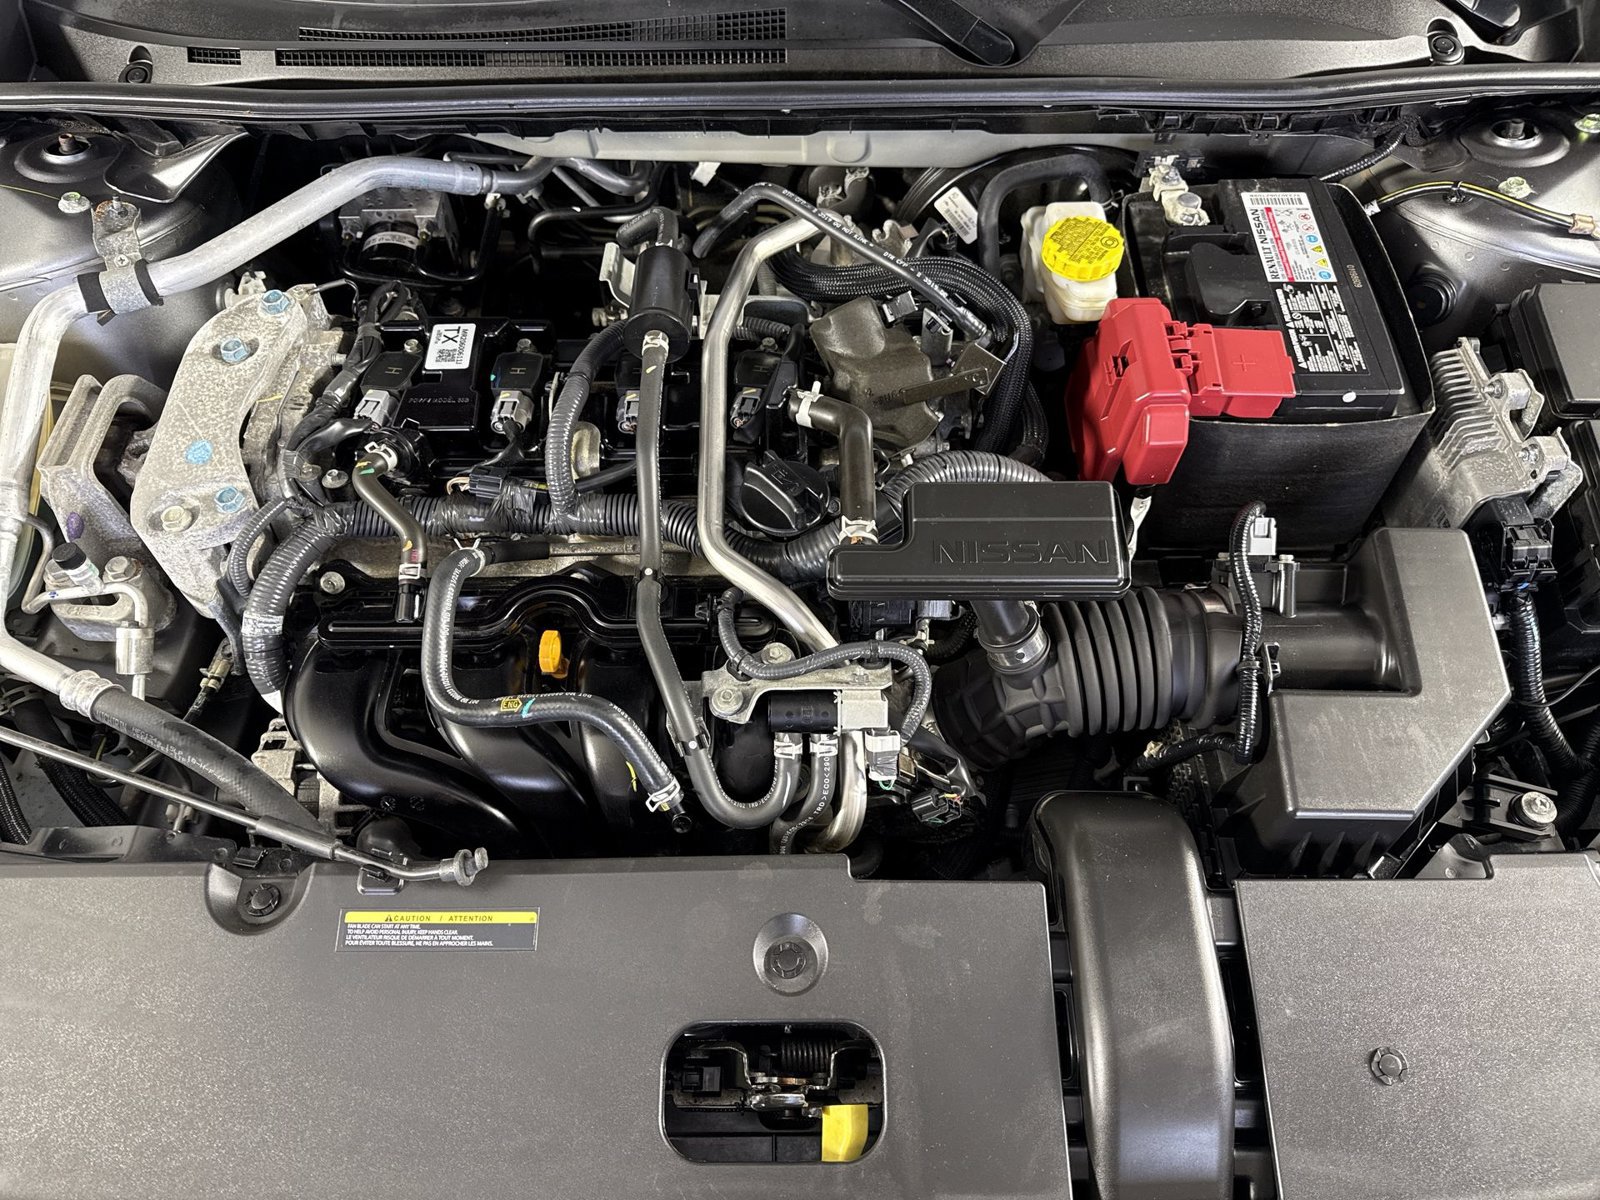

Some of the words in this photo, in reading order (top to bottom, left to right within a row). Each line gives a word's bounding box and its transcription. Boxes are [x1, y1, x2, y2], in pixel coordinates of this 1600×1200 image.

[1249, 209, 1268, 243] NISSAN
[1261, 246, 1280, 279] RENAULT
[442, 326, 461, 344] TX
[934, 539, 1110, 564] NISSAN
[503, 700, 518, 708] ENG
